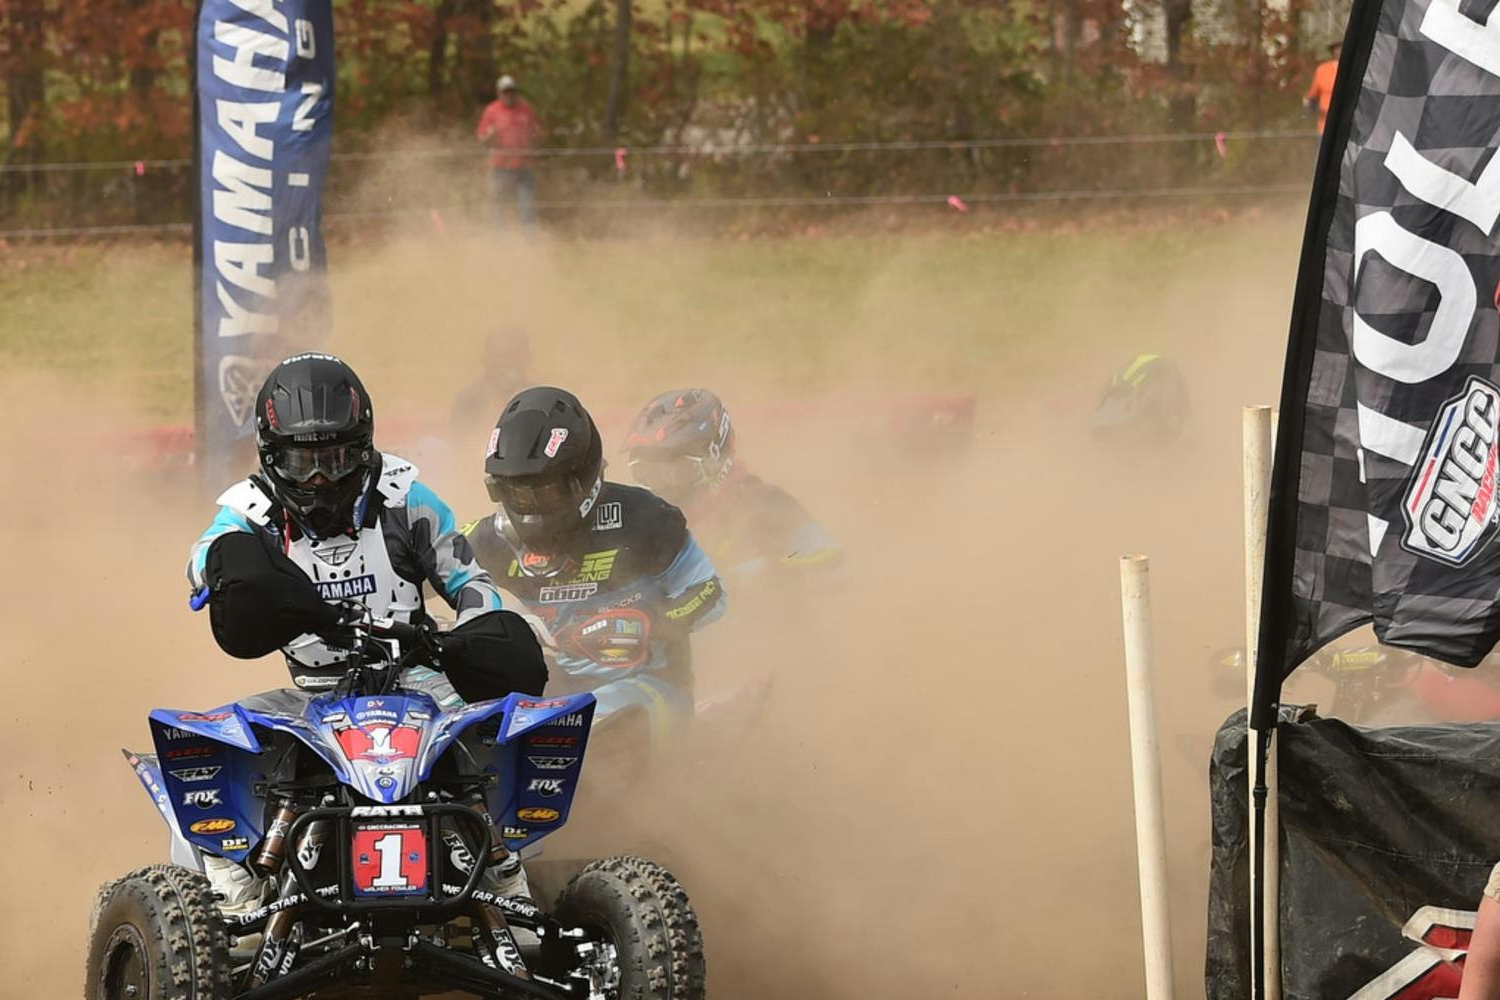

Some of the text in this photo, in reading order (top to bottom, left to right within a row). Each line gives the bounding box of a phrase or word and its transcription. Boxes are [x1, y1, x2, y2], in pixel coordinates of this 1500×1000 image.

[1421, 388, 1497, 551] GNCC
[366, 727, 397, 755] 1
[372, 833, 408, 887] 1
[240, 907, 269, 926] LONE
[269, 894, 299, 915] STAR
[471, 889, 494, 902] TAR
[494, 896, 538, 917] RACING
[252, 935, 286, 984] FOX
[490, 928, 528, 976] FOX
